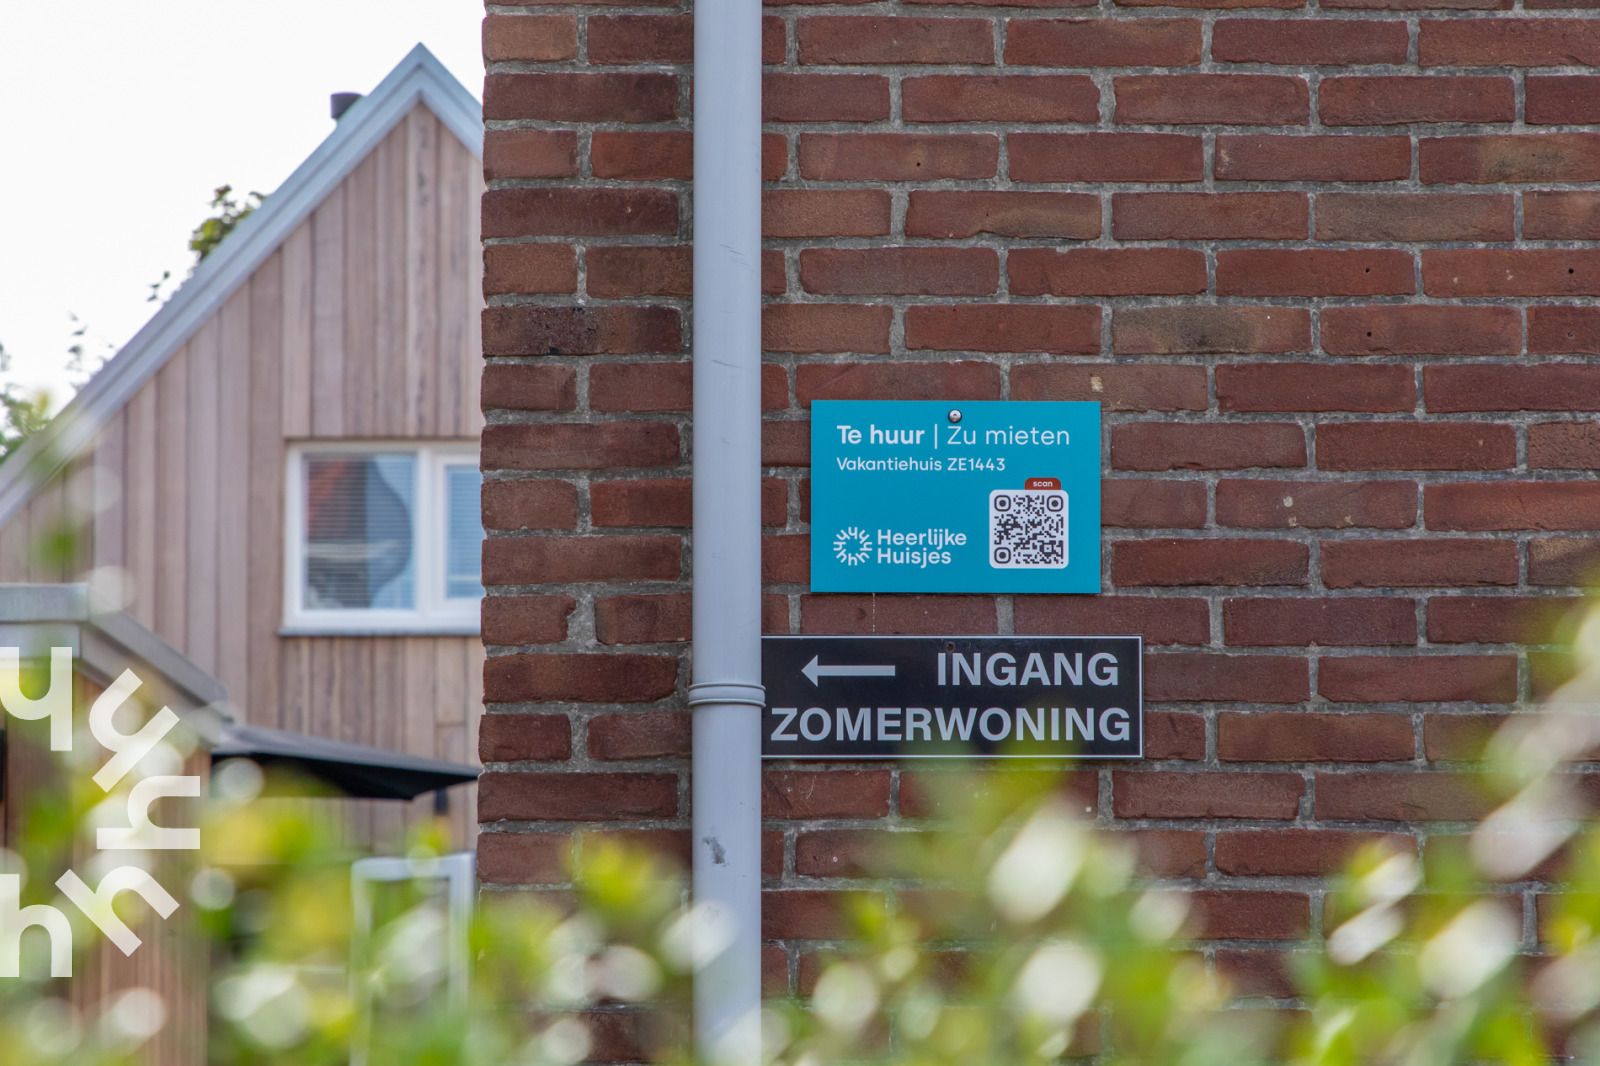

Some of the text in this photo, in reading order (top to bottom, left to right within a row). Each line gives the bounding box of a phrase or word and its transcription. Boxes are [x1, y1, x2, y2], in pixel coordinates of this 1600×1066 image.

[836, 425, 862, 444] Te
[870, 424, 925, 445] huur
[947, 426, 976, 445] Zu
[985, 425, 1070, 445] mieten
[836, 457, 1006, 471] Vakantiehuis ZE1443
[877, 528, 967, 550] Heerlijke
[877, 548, 951, 569] Huisjes
[937, 652, 1119, 686] INGANG
[770, 707, 1131, 742] ZOMERWONING
